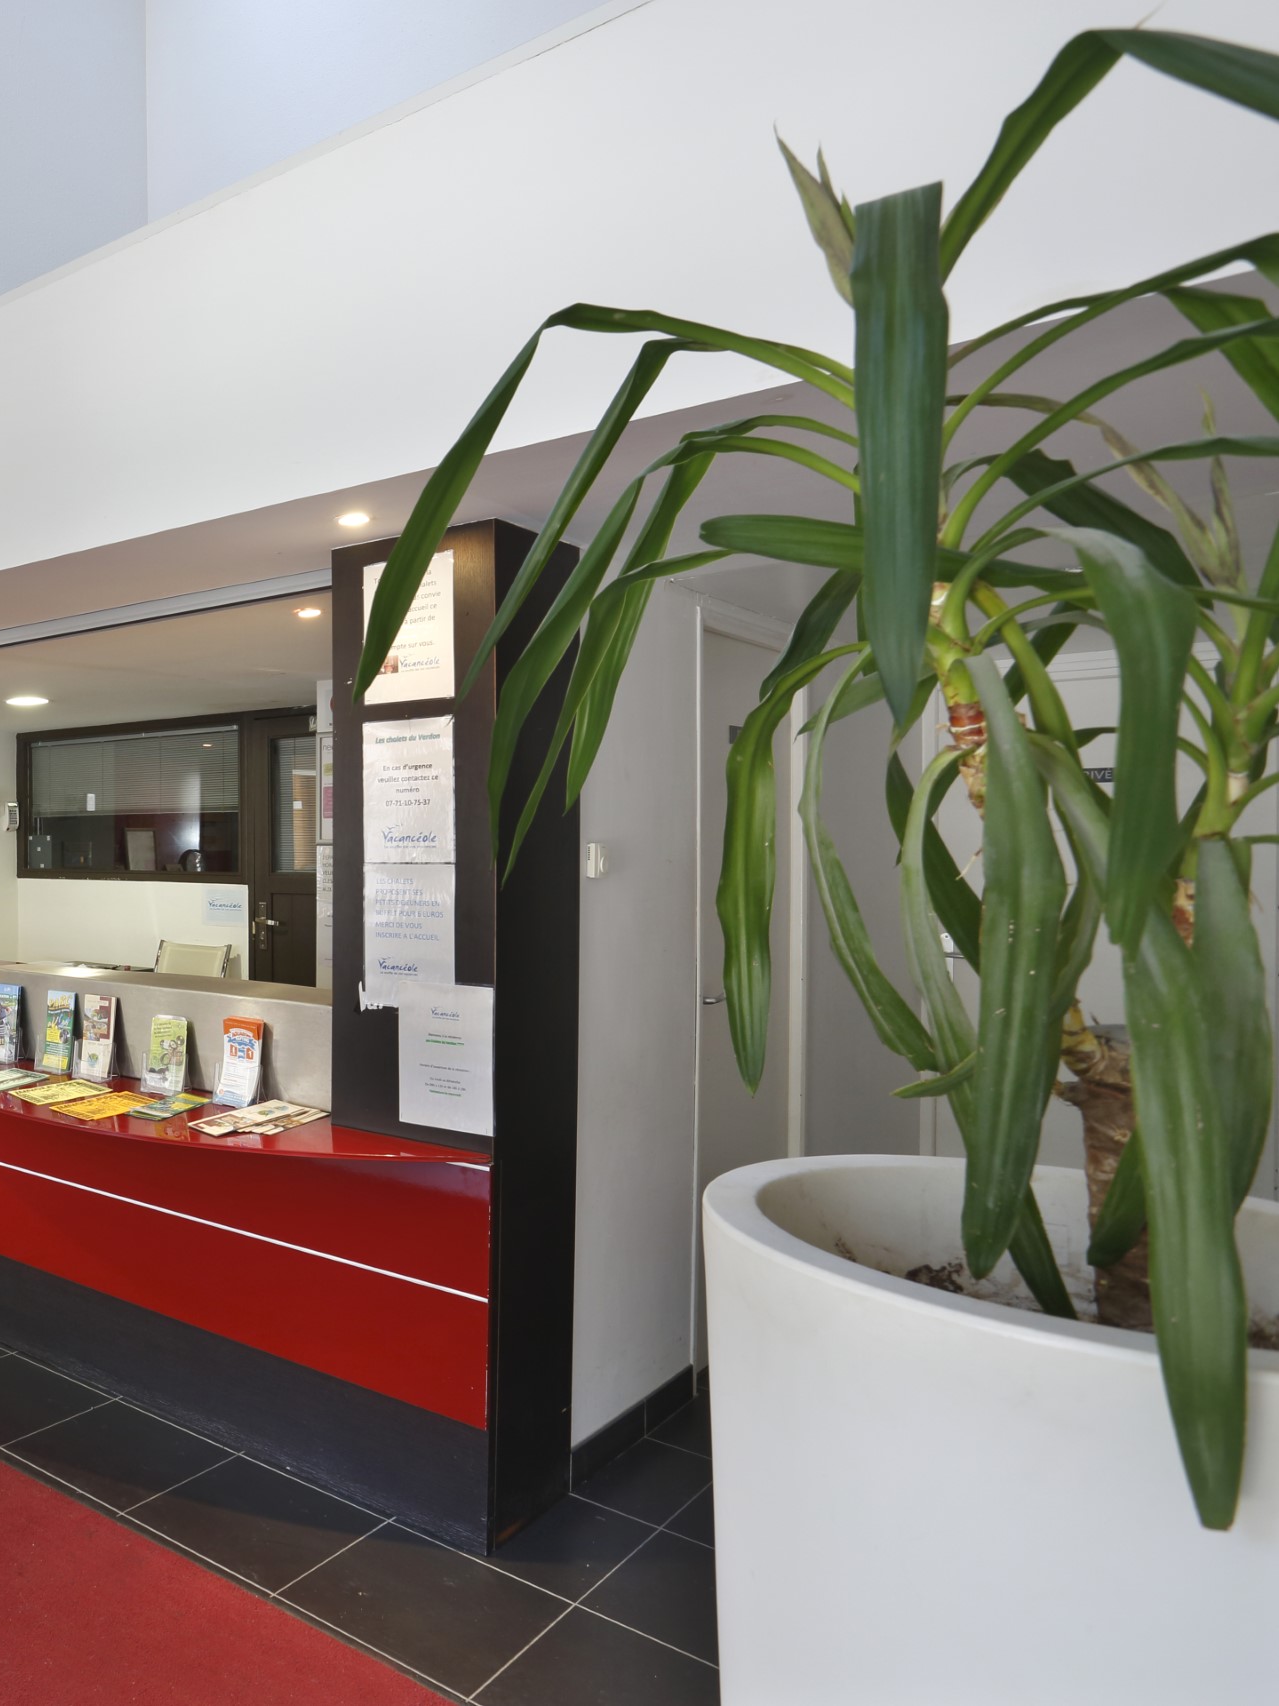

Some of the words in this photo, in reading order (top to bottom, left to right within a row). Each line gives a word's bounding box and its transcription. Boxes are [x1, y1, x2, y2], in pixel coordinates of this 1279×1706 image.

[408, 734, 417, 742] du
[418, 733, 441, 741] Verdon
[402, 763, 433, 771] d'urgence
[395, 786, 420, 794] numéro
[382, 830, 437, 844] Vacancéole
[375, 931, 402, 939] INSCRIRE
[409, 932, 440, 941] L'ACCUEIL
